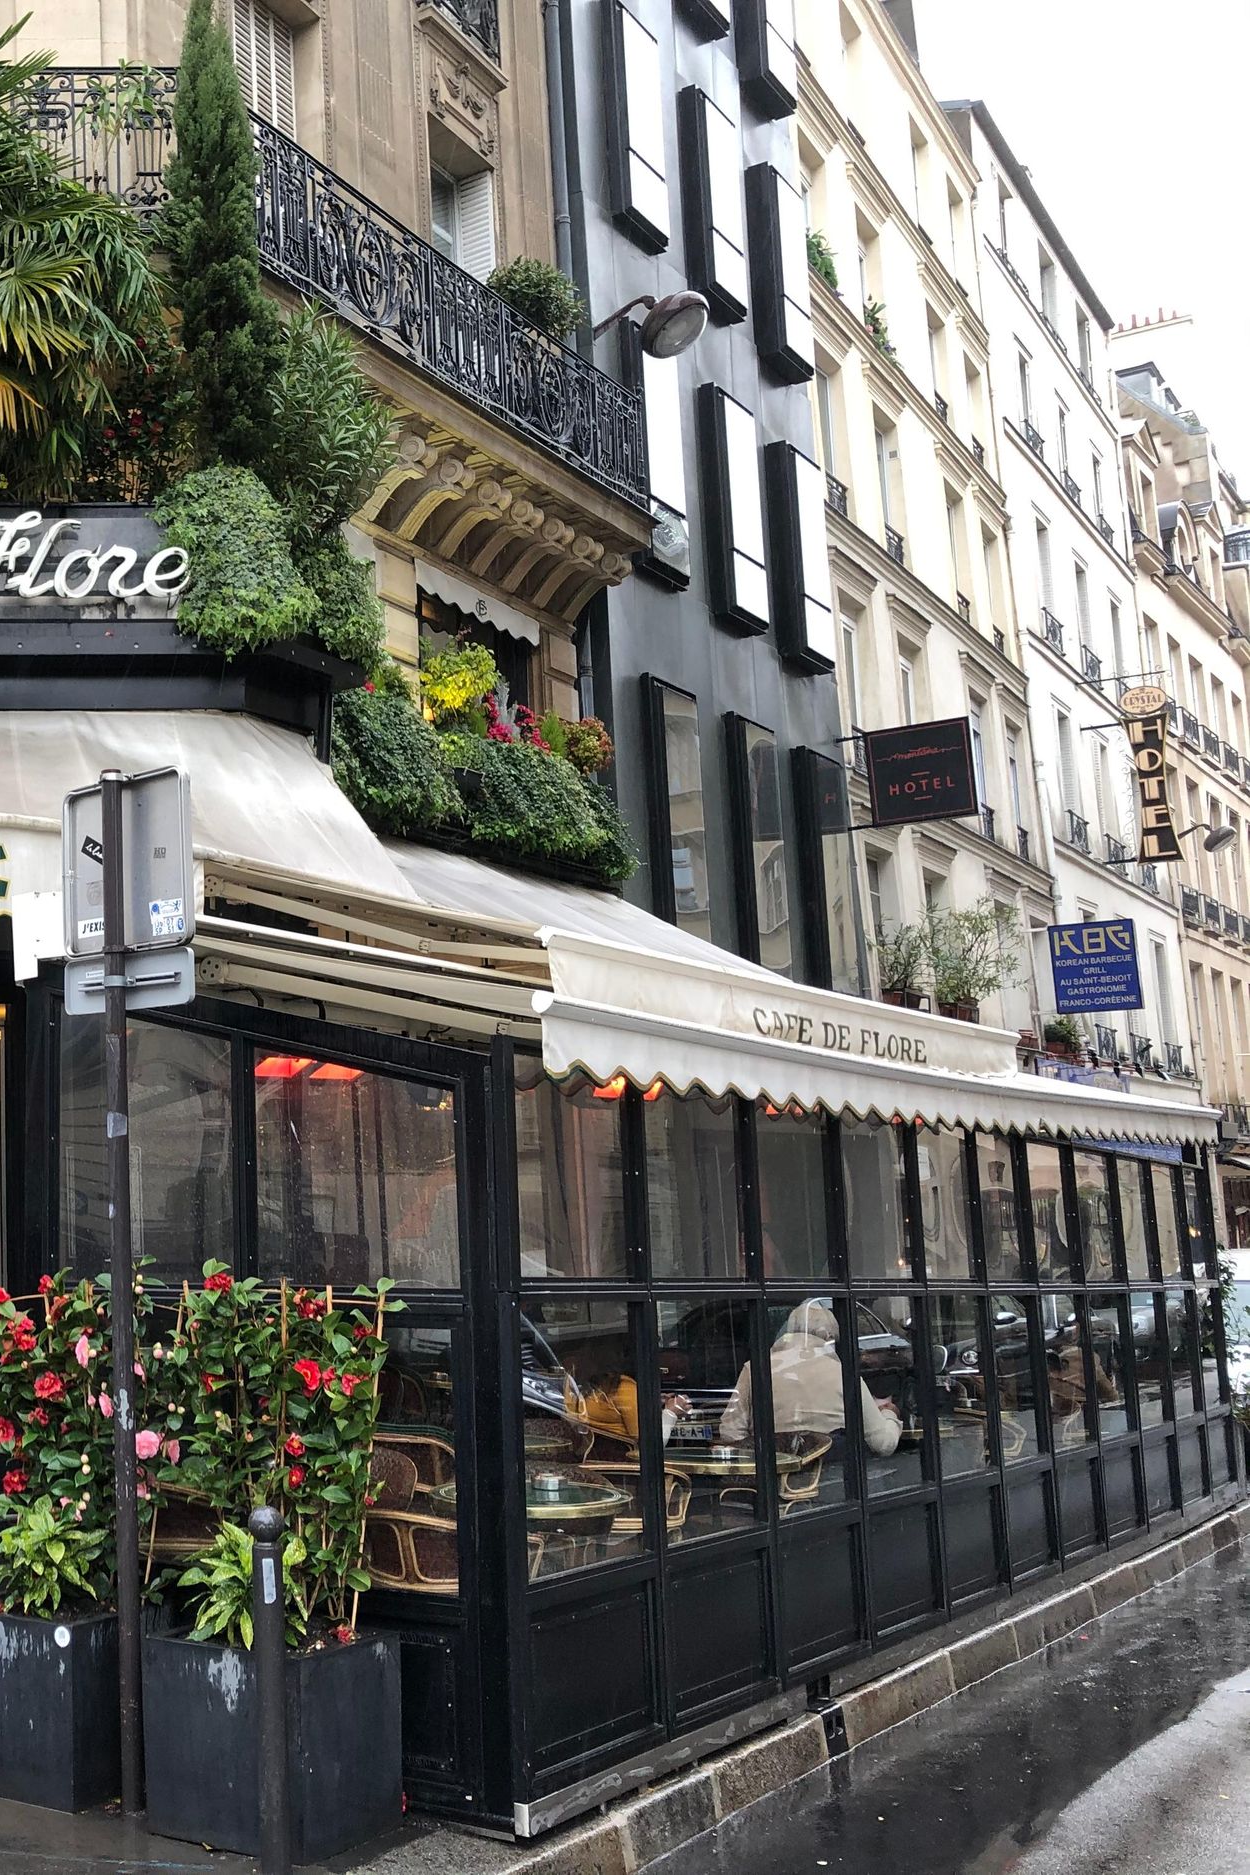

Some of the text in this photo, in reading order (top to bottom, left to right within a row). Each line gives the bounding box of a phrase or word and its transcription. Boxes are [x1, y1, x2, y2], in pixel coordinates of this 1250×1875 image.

[1123, 693, 1163, 707] CRYSTAL
[889, 776, 955, 796] HOTEL
[1128, 718, 1178, 858] HOTEL
[1055, 953, 1133, 968] KOREAN BARBECUE
[1083, 966, 1107, 975] GRILL
[1060, 973, 1132, 987] AU SAINT-BENOIT
[1067, 984, 1128, 996] GASTRONOMIE
[752, 1007, 927, 1063] CAFE DE FLORE
